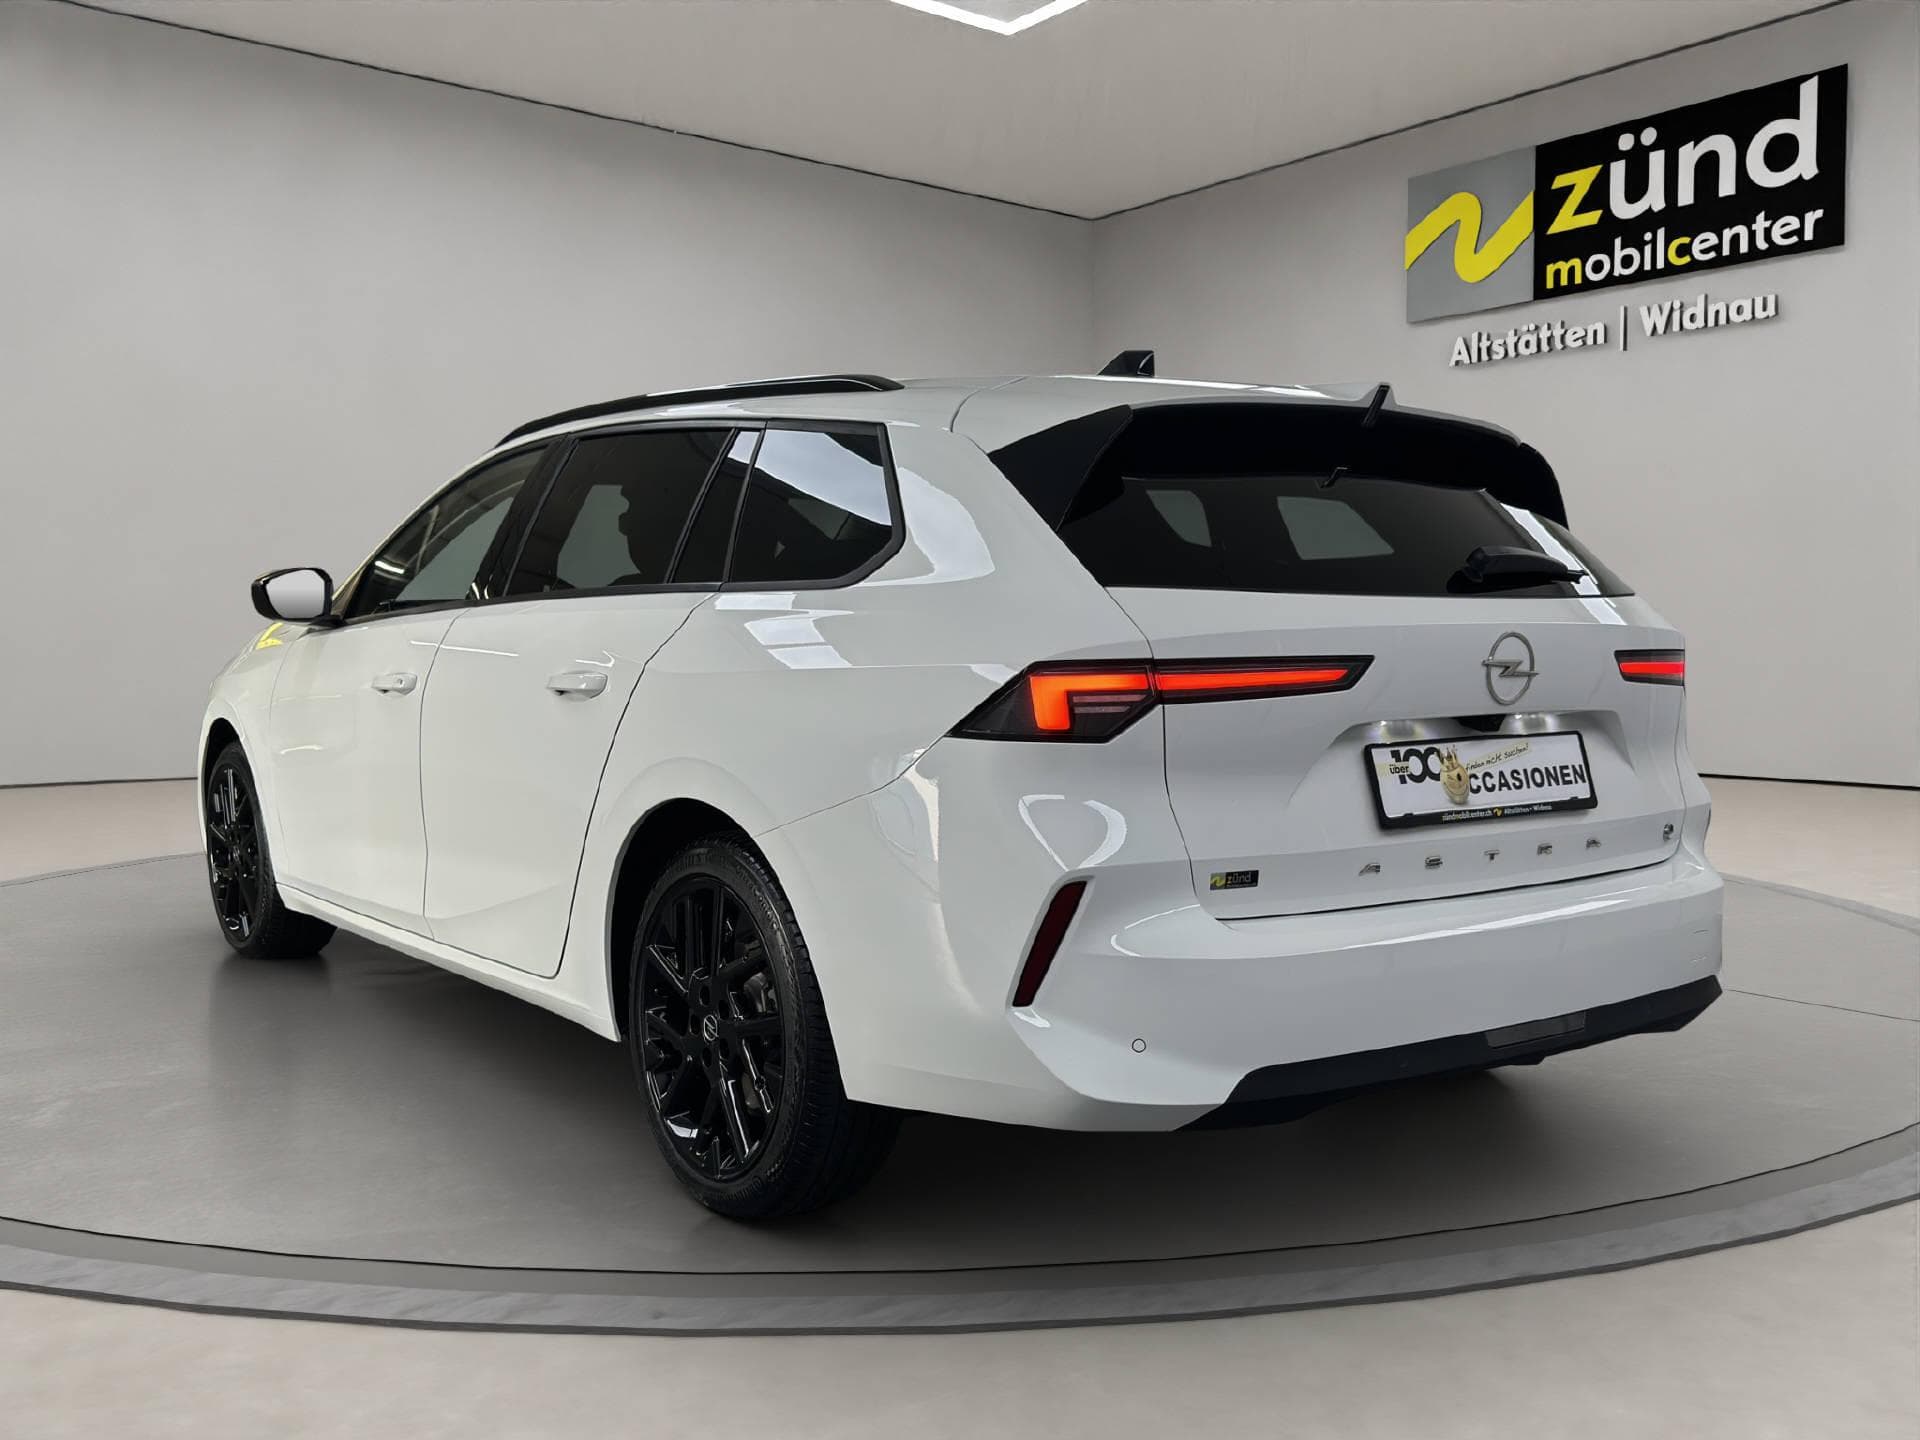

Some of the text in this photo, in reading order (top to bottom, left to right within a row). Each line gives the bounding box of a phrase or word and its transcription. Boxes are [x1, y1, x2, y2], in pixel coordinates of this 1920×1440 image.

[1546, 75, 1820, 235] zünd
[1546, 207, 1824, 289] mobilcenter
[1449, 318, 1607, 367] Altstätten
[1640, 293, 1778, 337] Widnau
[1390, 763, 1409, 774] über
